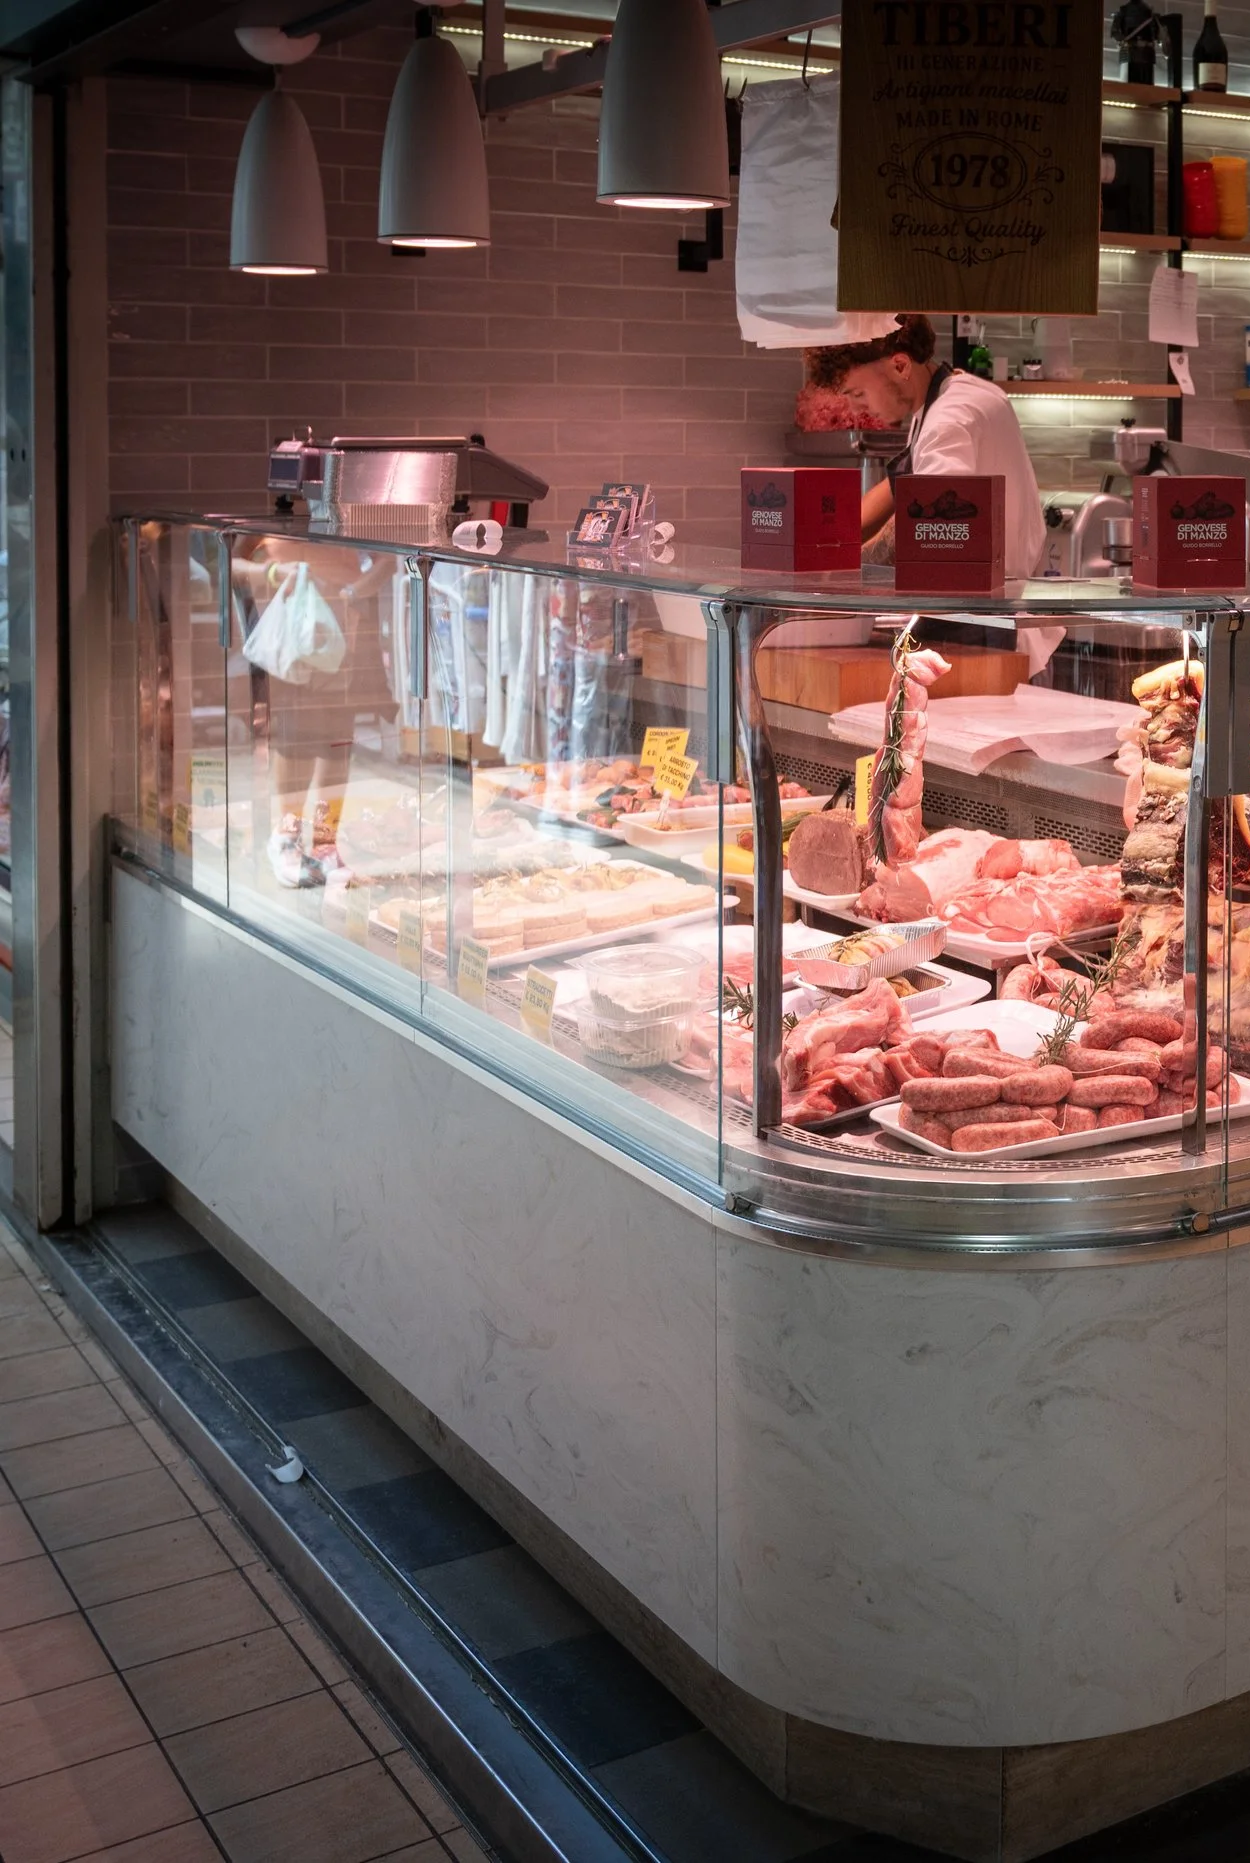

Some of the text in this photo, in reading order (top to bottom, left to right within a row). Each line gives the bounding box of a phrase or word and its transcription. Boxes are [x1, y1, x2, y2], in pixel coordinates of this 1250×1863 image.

[873, 3, 1074, 49] TIBERI
[897, 55, 1044, 72] III GENERAZIONE
[872, 78, 1070, 106] Artigiani macellai
[896, 109, 1043, 132] MADE IN ROME
[930, 153, 1010, 188] 1978
[889, 213, 1046, 245] Finest Quality
[752, 510, 783, 519] GENOVESE
[752, 518, 783, 527] DI MANZO
[915, 523, 970, 532] GENOVESE
[1178, 523, 1227, 532] GENOVESE
[915, 532, 970, 541] DI MANZO
[1177, 532, 1228, 540] DI MANZO
